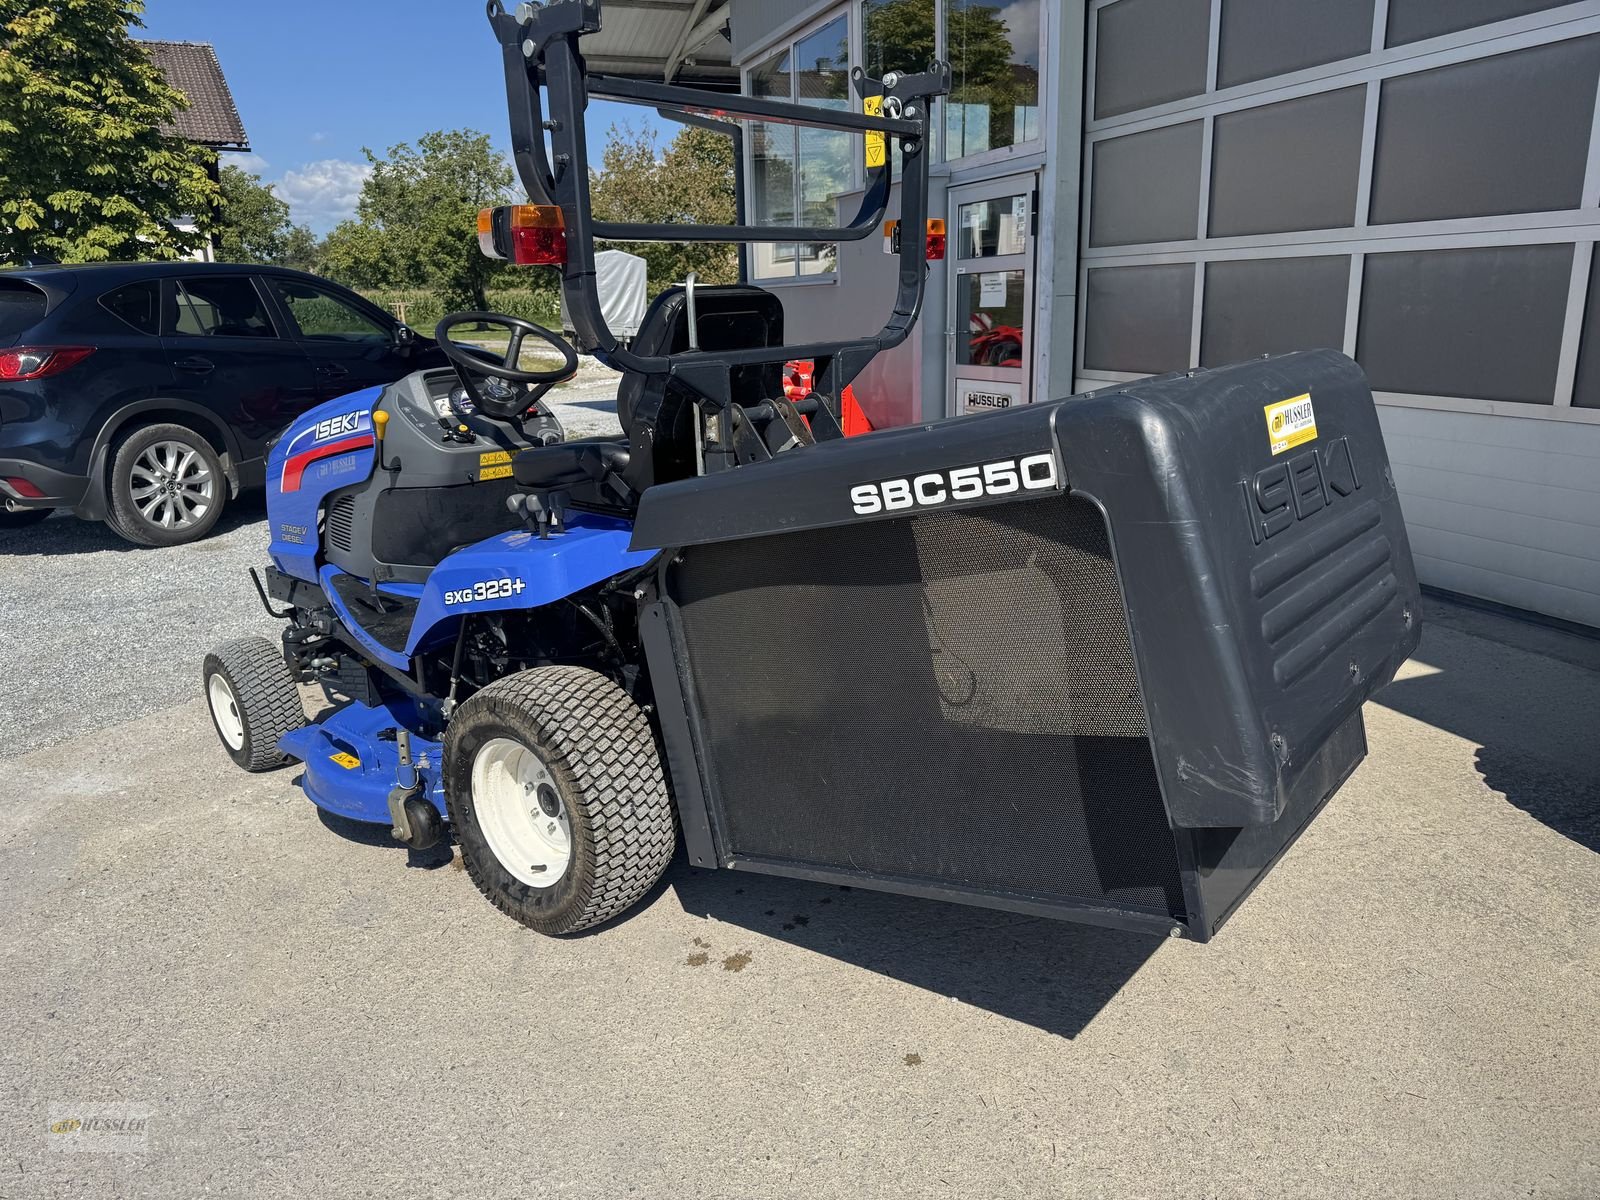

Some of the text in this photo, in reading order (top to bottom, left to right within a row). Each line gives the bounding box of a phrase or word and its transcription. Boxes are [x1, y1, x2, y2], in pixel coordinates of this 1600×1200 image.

[315, 411, 360, 440] ISEKI
[850, 453, 1058, 515] SBC550
[1232, 436, 1362, 546] ISEKI
